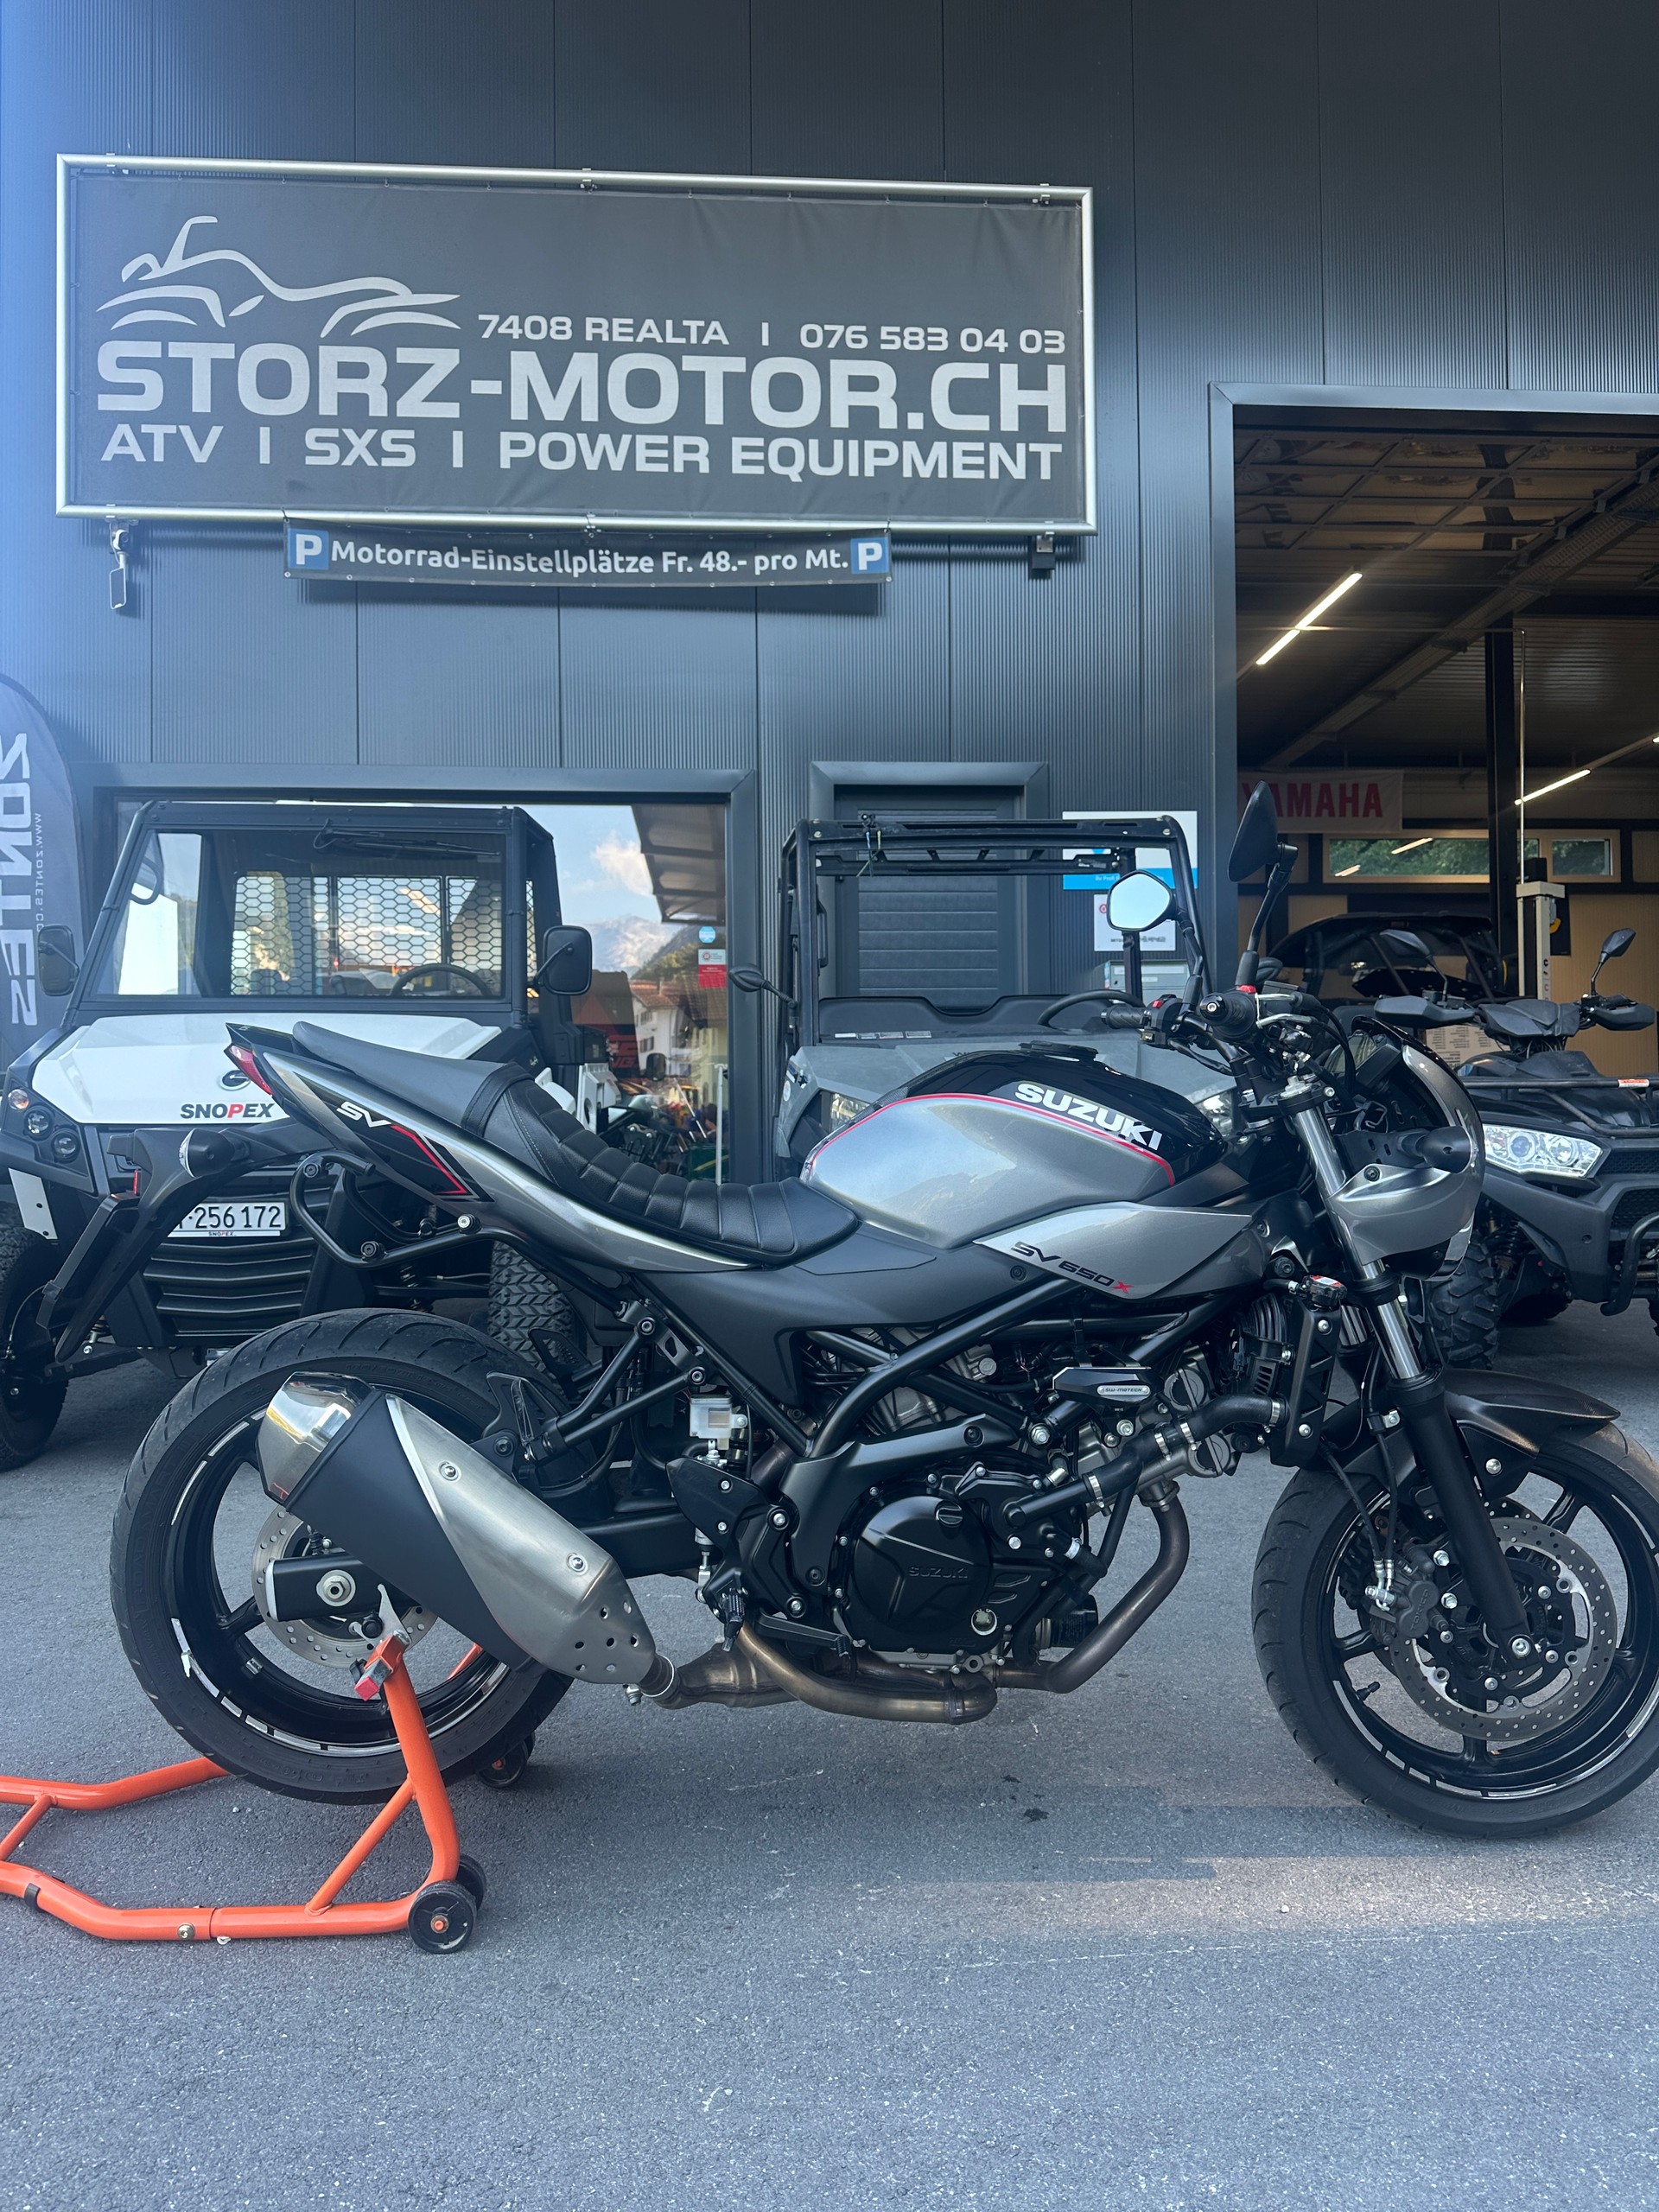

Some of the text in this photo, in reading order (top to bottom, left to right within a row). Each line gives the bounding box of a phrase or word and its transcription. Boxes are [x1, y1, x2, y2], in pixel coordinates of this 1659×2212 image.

[478, 314, 548, 340] 7408
[585, 316, 730, 346] REALTA
[800, 323, 868, 349] 076
[880, 326, 949, 352] 583
[960, 327, 1009, 353] 04
[1019, 328, 1065, 354] 03
[97, 340, 1067, 433] STORZ-MOTOR.CH
[100, 423, 224, 463] ATV
[304, 428, 416, 467] SXS
[499, 431, 710, 474] POWER
[731, 436, 1063, 483] EQUIPMENT
[332, 540, 655, 578] Motorrad-Einstellplätze
[662, 551, 693, 573] Fr.
[699, 551, 747, 573] 48.-
[754, 554, 798, 575] pro
[805, 549, 849, 569] Mt.
[180, 1103, 275, 1119] SNOPEX
[336, 1101, 392, 1128] SV
[1014, 1083, 1163, 1151] SUZUKI
[908, 1566, 969, 1580] SUZUKI
